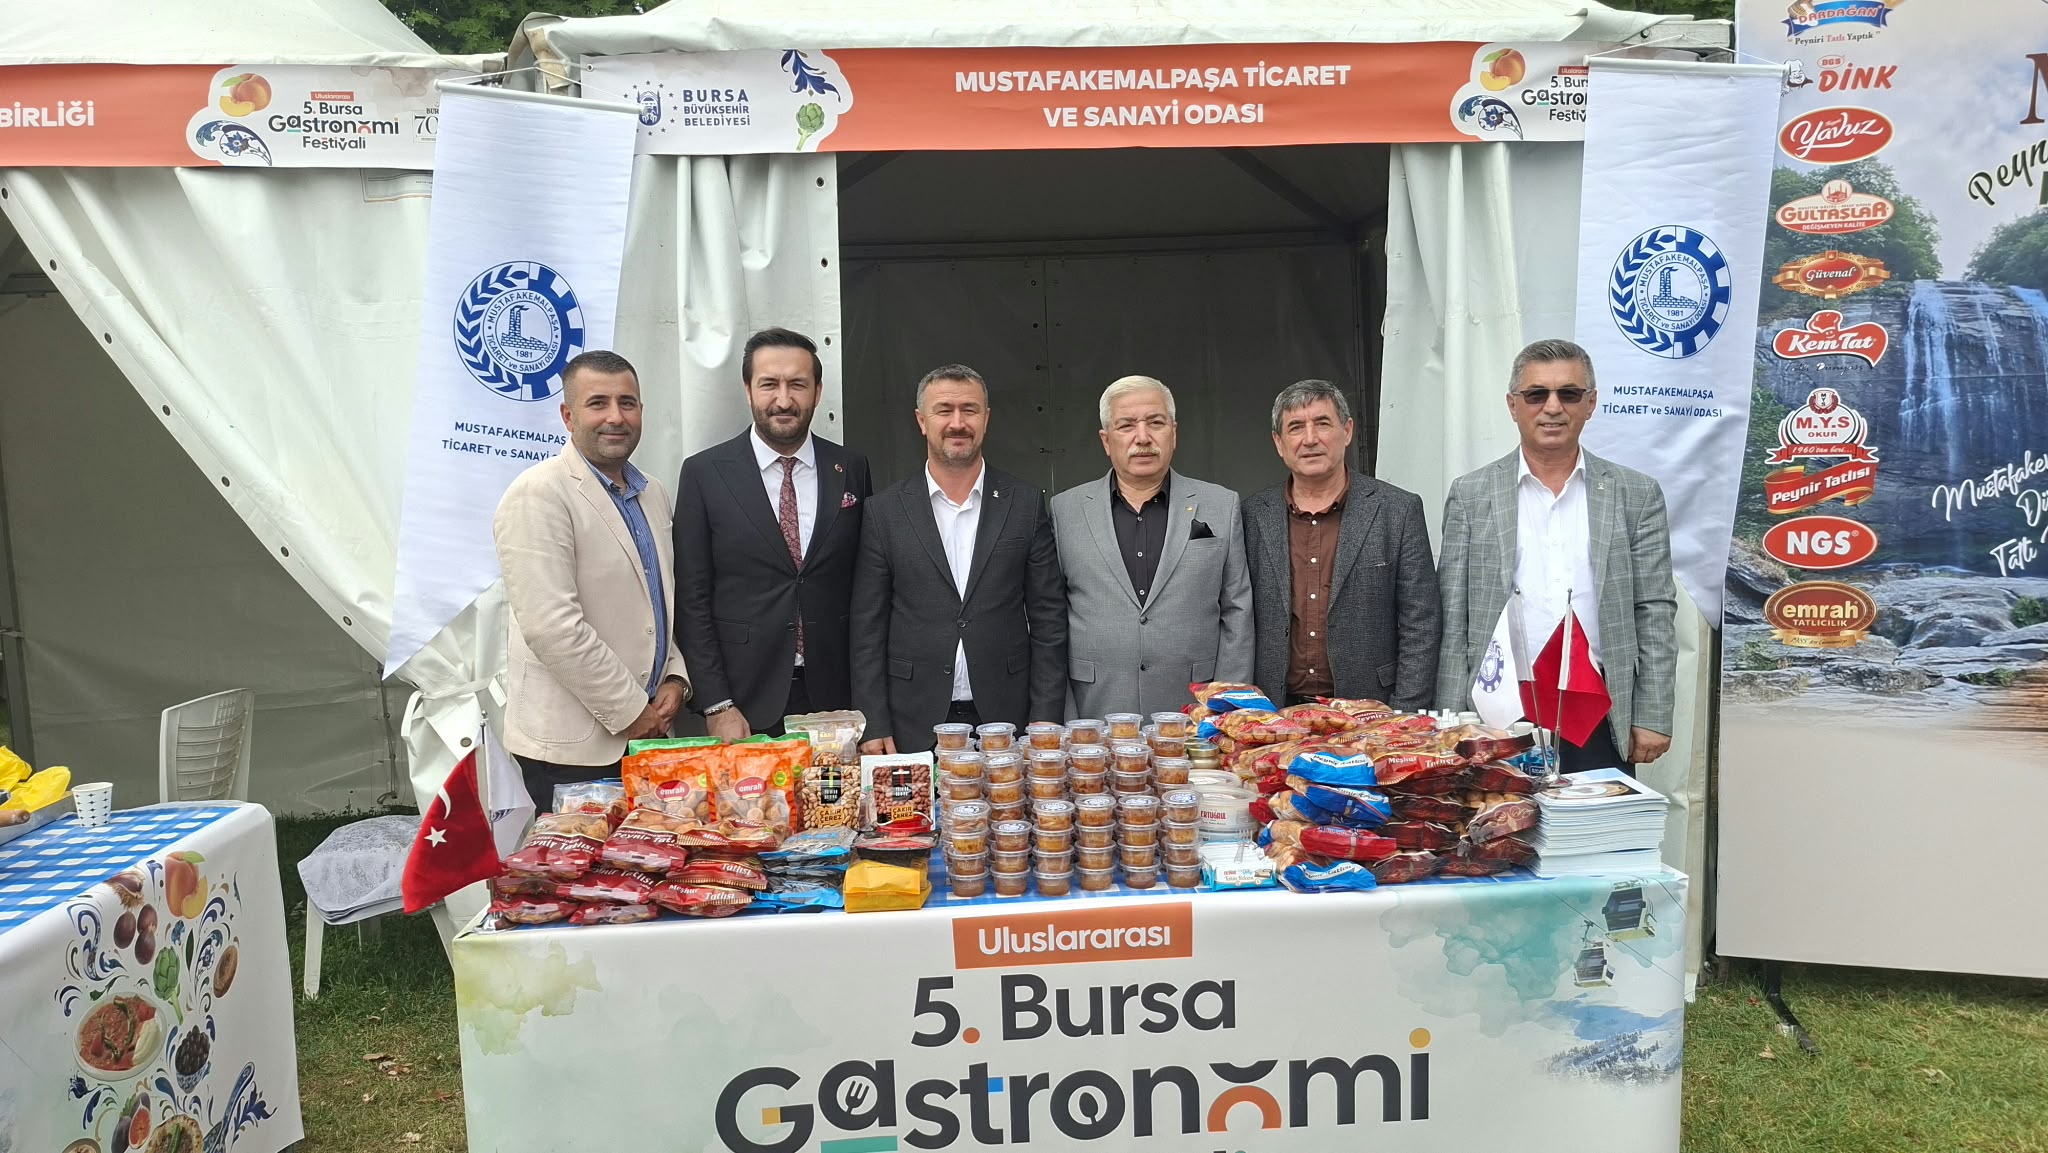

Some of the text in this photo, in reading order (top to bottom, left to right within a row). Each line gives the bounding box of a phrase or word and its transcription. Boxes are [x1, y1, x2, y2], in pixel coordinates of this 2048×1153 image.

[1797, 5, 1878, 23] DARDAĞAN
[1795, 31, 1873, 46] Peyniri Tatlı Yaptık
[955, 60, 1351, 92] MUSTAFAKEMALPAŞA TİCARET
[1818, 62, 1898, 93] DİNK
[683, 89, 748, 103] BURSA
[1521, 89, 1587, 106] Gastro
[0, 101, 94, 127] BİRLİĞİ
[303, 102, 363, 115] 5. Bursa
[684, 103, 750, 115] BÜYÜKŞEHİR
[1043, 99, 1264, 127] VE SANAYİ ODASI
[268, 114, 399, 135] Gastronomi
[684, 115, 750, 126] BELEDİYESİ
[303, 136, 366, 150] Festivali
[1790, 112, 1884, 158] Yavuz
[1802, 221, 1866, 231] DEĞİŞMEYEN KALİTE
[1639, 254, 1708, 291] MUSTAFAKEMALPAŞA
[1806, 267, 1855, 281] Güvenal
[487, 291, 559, 332] MUSTAFAKEMALPAŞA
[1638, 297, 1661, 326] TİCARET
[1661, 321, 1670, 329] ve
[1694, 299, 1708, 321] ODASI
[1667, 309, 1684, 317] 1981
[486, 334, 509, 367] TİCARET
[509, 362, 518, 370] ve
[545, 341, 559, 366] ODASI
[515, 349, 534, 359] 1981
[1613, 385, 1714, 399] MUSTAFAKEMALPAŞA
[1602, 402, 1723, 418] TİCARET ve SANAYİ ODASI
[1796, 416, 1850, 429] M.Y.S
[454, 421, 566, 446] MUSTAFAKEMALPAŞ
[441, 438, 550, 462] TİCARET ve SANAYİ
[1772, 467, 1870, 505] Peynir Tatlısı
[1787, 530, 1851, 555] NGS
[1989, 537, 2038, 577] Tatlı
[1783, 601, 1859, 619] emrah
[1793, 619, 1848, 627] TATLICILIK
[660, 786, 685, 795] emrah
[705, 892, 735, 900] Tatlısı
[978, 924, 1171, 956] Uluslararası
[911, 973, 1236, 1048] 5. Bursa
